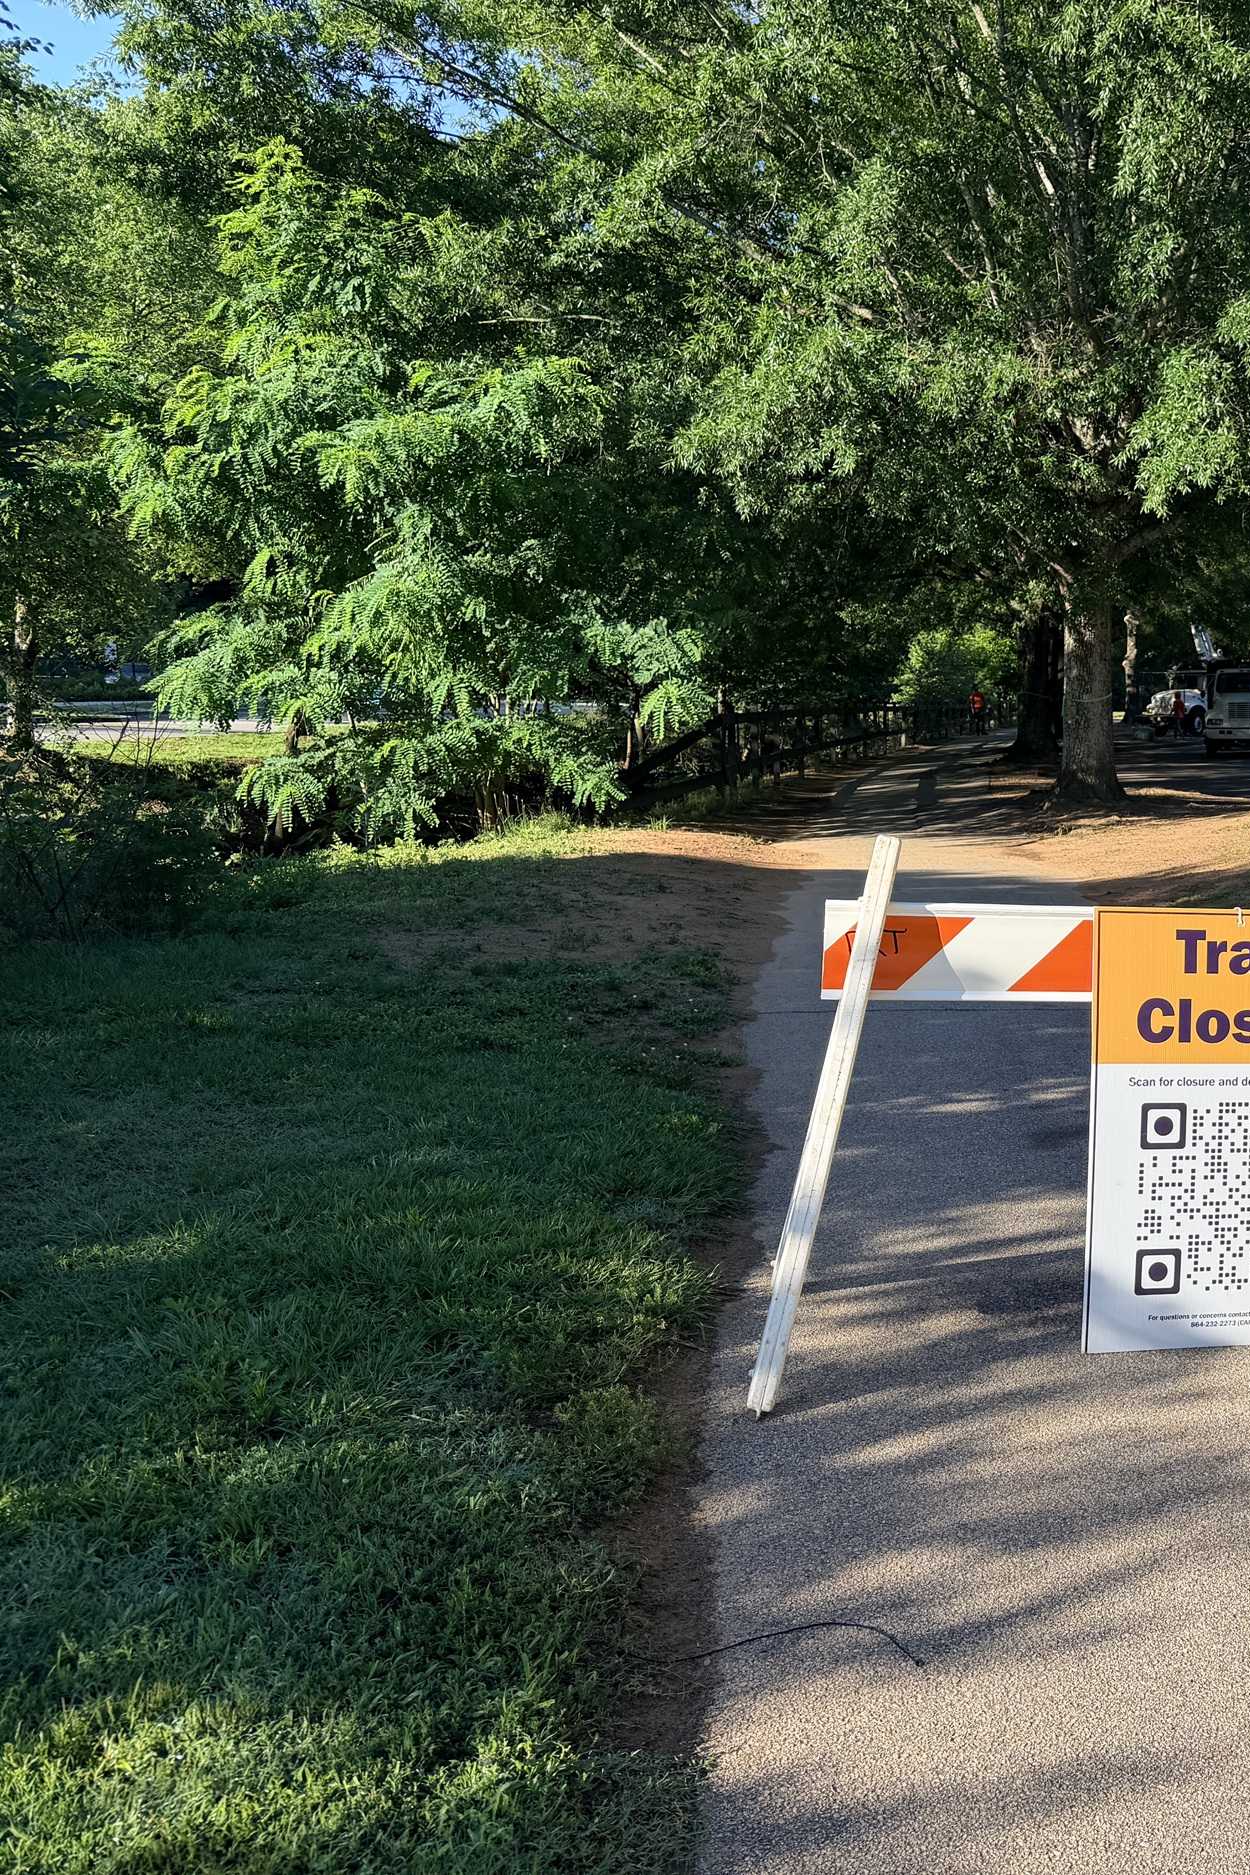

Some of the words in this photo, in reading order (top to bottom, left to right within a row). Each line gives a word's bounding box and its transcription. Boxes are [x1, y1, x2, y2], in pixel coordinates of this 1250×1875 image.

[1128, 1076, 1156, 1087] Scan
[1159, 1076, 1174, 1087] for
[1176, 1076, 1215, 1087] closure
[1218, 1076, 1239, 1087] and
[1159, 1313, 1190, 1322] questions
[1199, 1312, 1227, 1320] concerns
